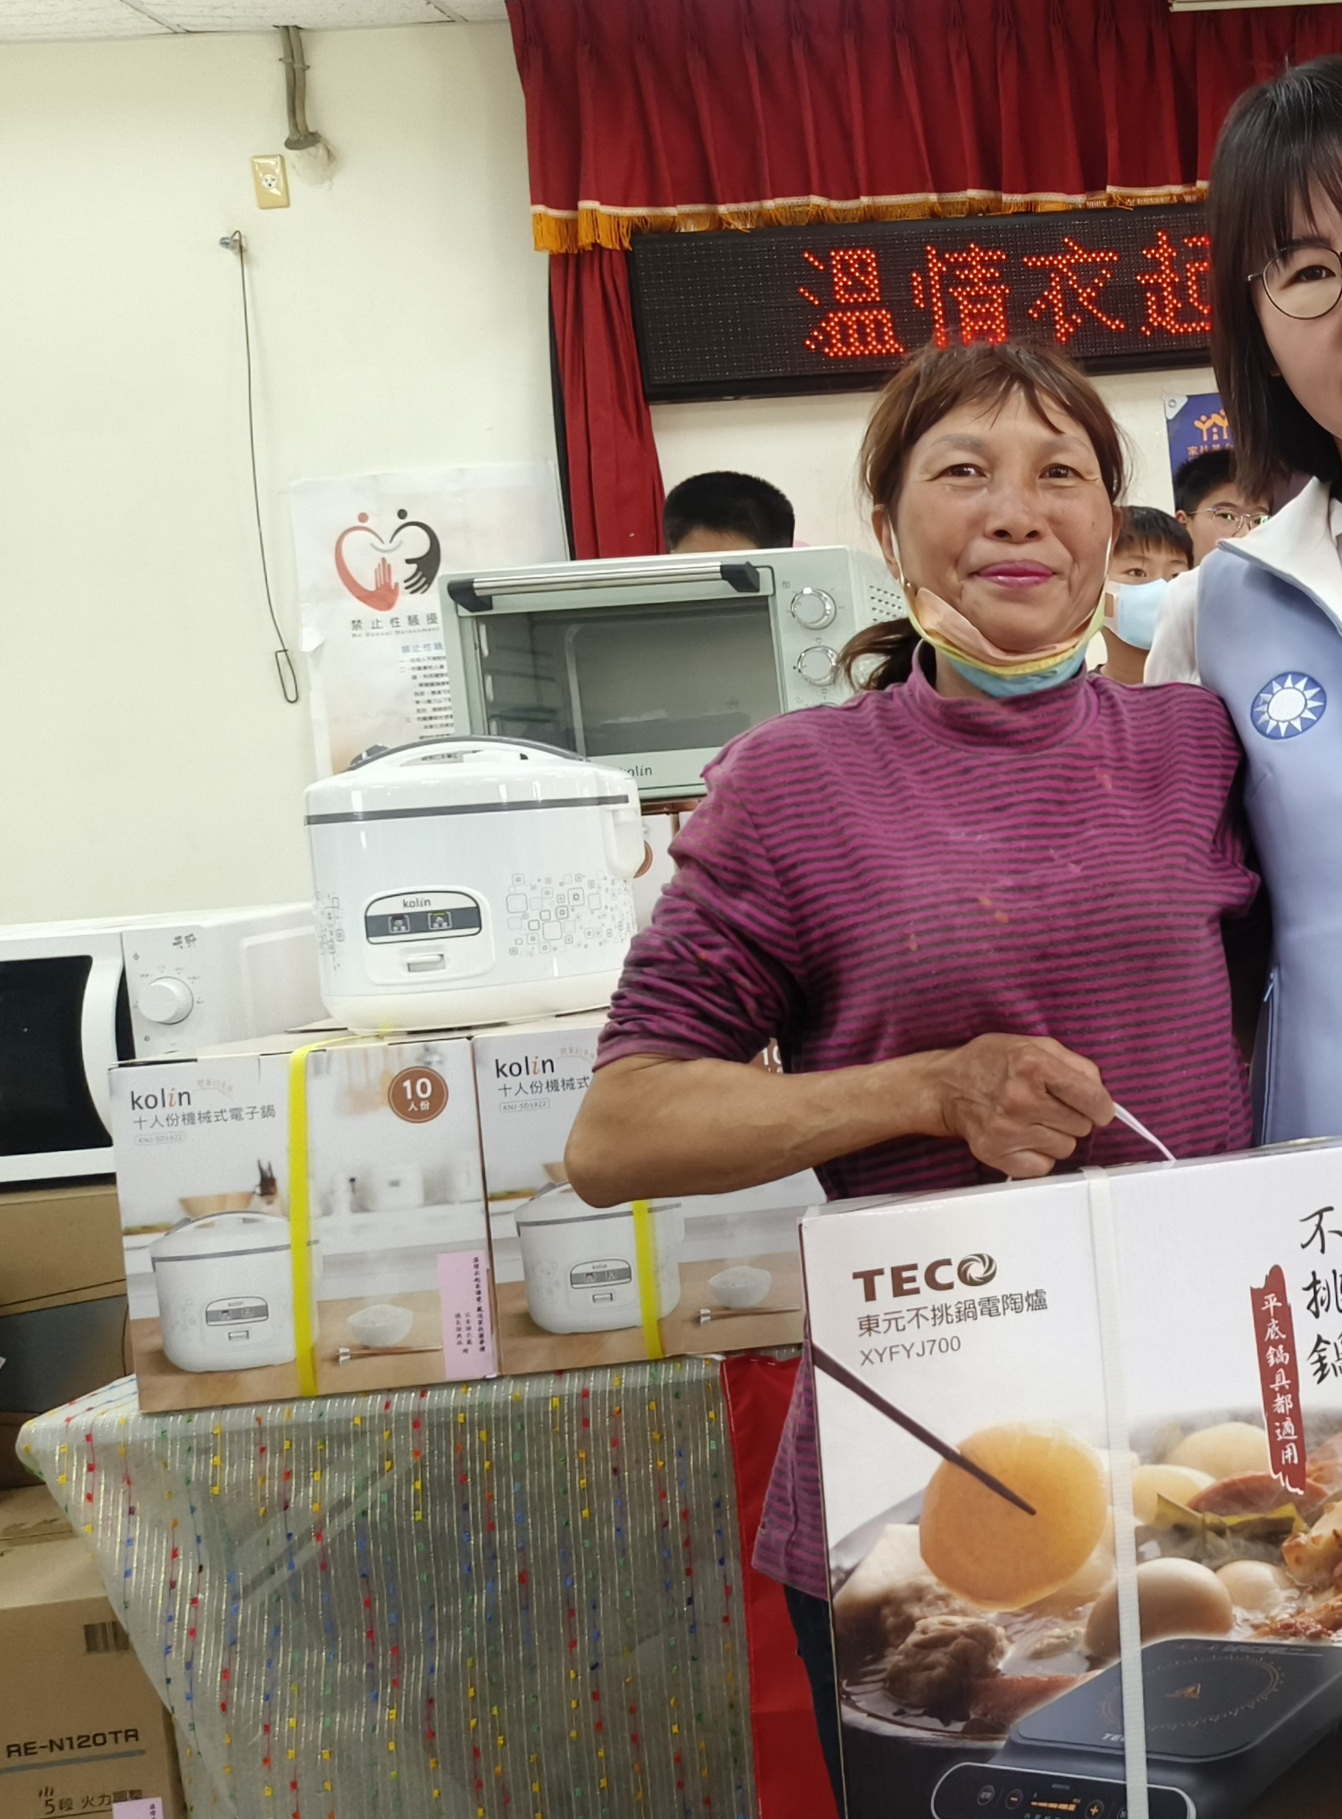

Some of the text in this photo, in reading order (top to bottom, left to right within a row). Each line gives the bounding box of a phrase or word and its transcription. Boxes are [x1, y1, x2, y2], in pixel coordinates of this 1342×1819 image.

[624, 765, 653, 777] olin
[402, 898, 431, 908] kolin
[495, 1055, 555, 1078] kolin
[402, 1077, 432, 1099] 10
[498, 1076, 590, 1097] 十人份機械式
[131, 1087, 192, 1110] kolin
[407, 1101, 431, 1112] 人份
[133, 1104, 276, 1130] 十人份機械式電子鍋
[852, 1253, 997, 1302] TECO
[857, 1289, 1048, 1337] 東元不挑鍋電陶爐
[860, 1335, 961, 1366] XYFYJ700
[1260, 1293, 1298, 1465] 平底鍋具都適用
[6, 1728, 139, 1758] RE-N120TR
